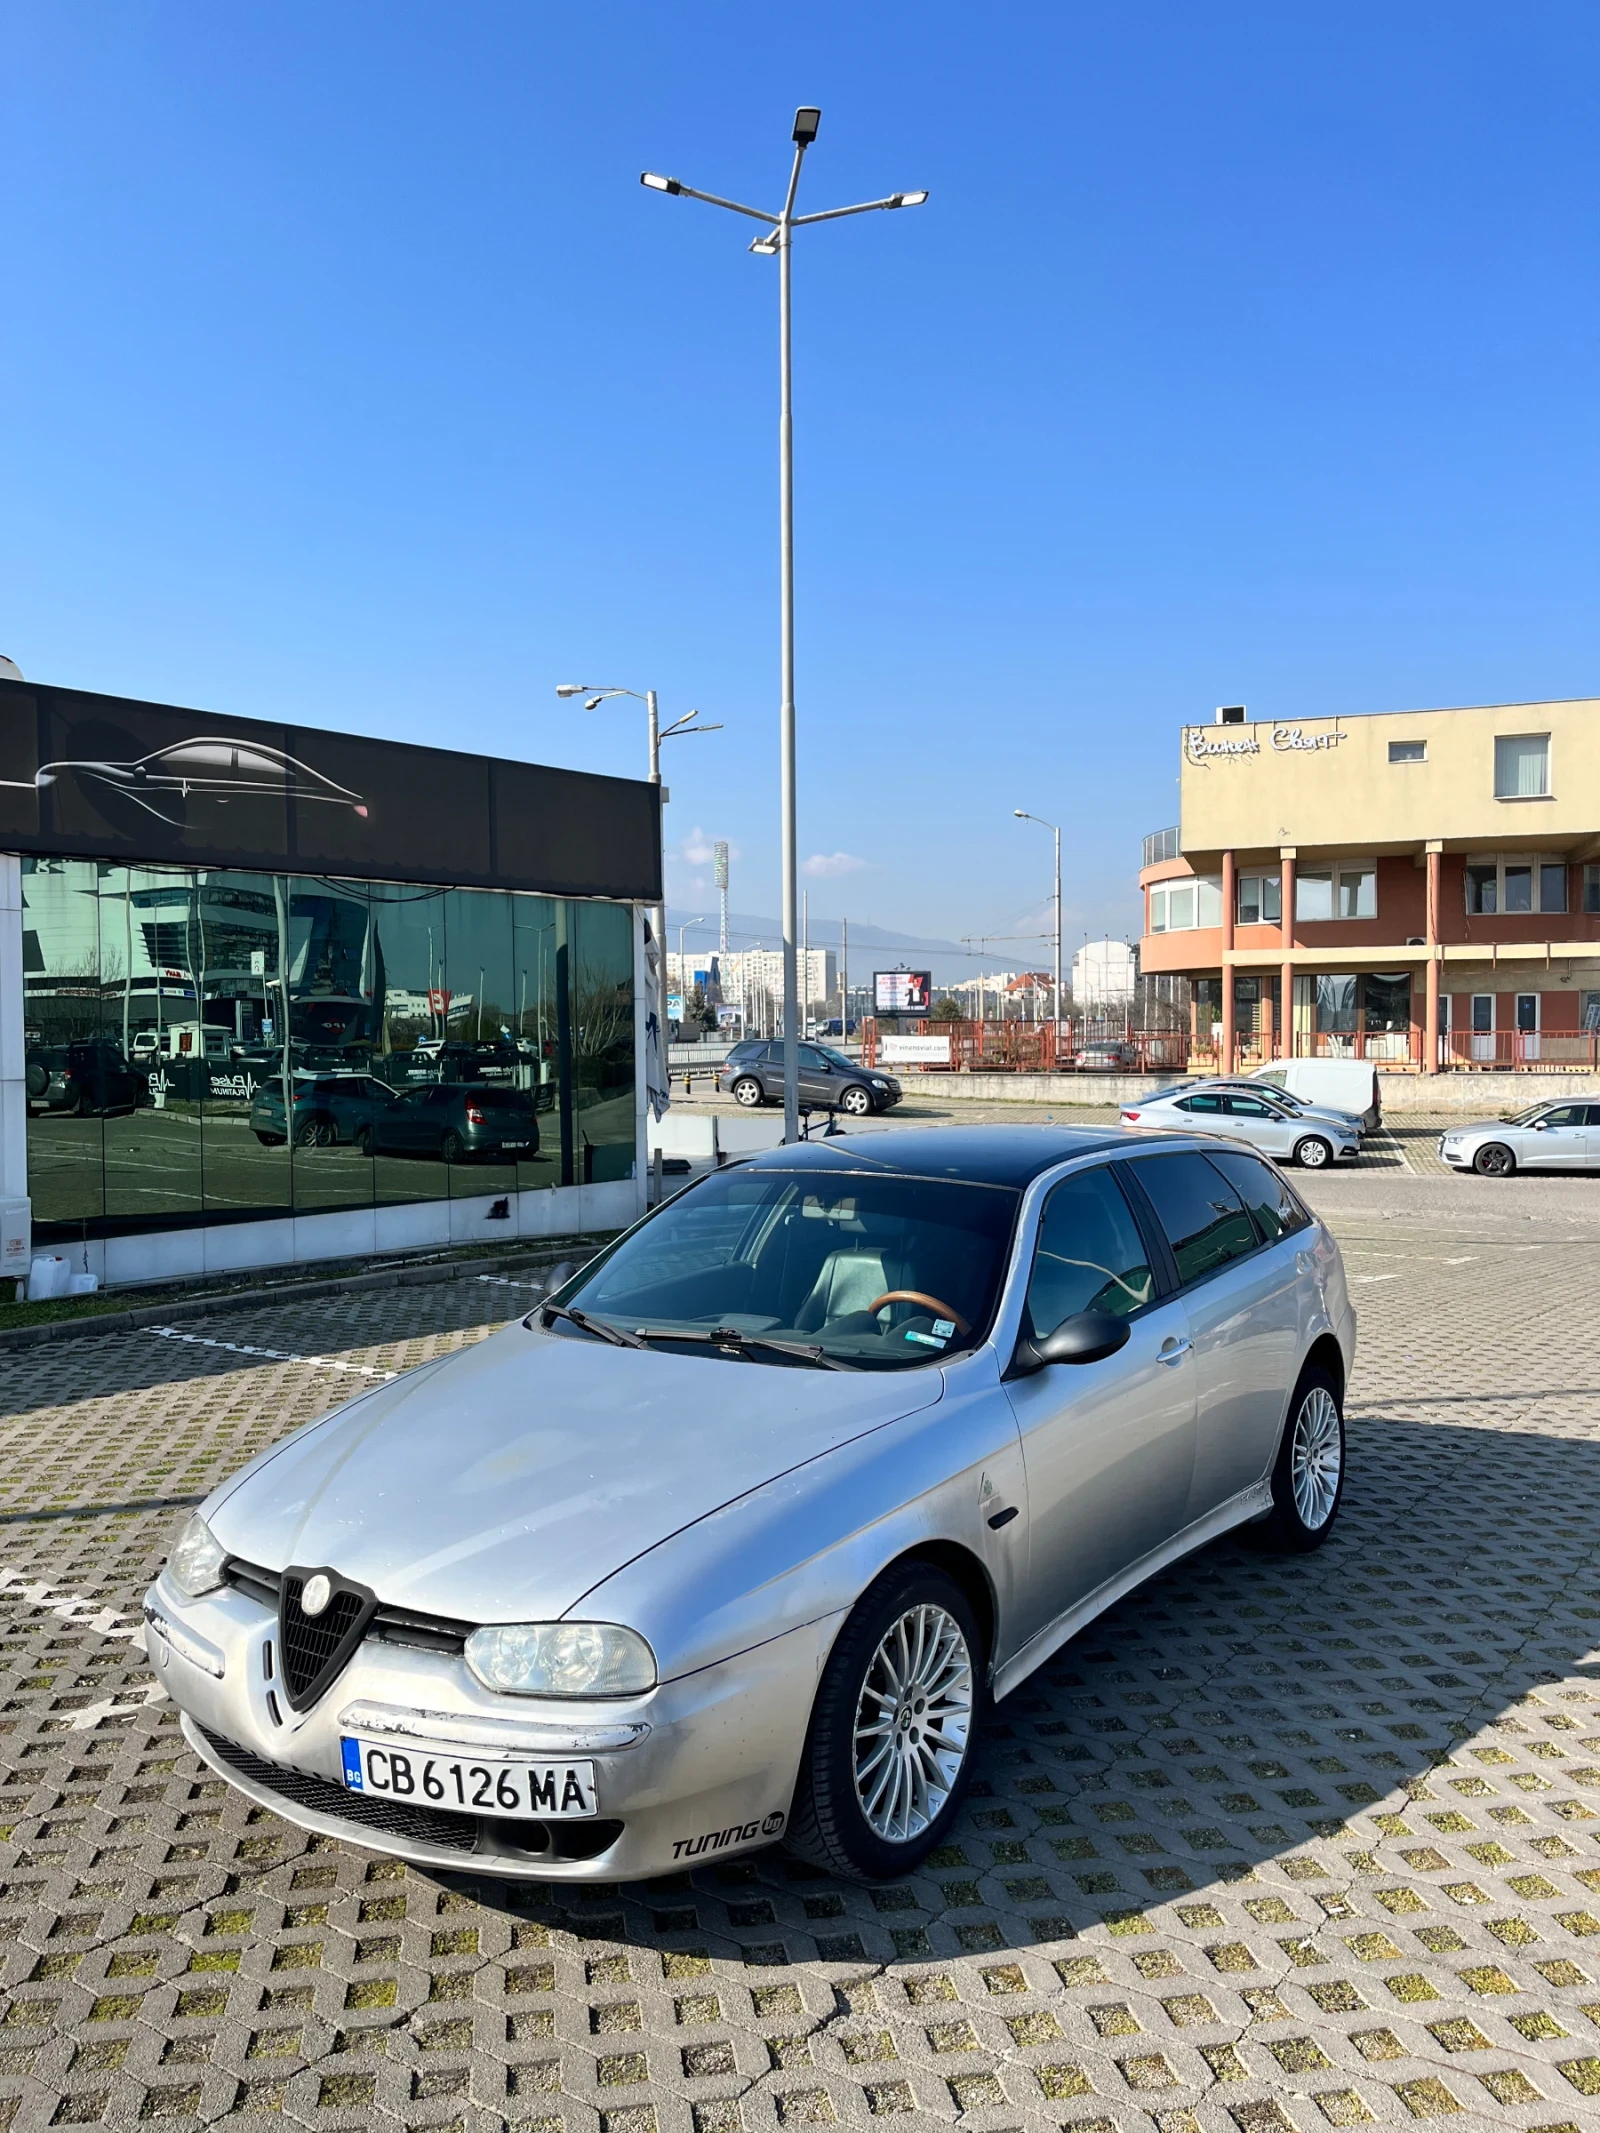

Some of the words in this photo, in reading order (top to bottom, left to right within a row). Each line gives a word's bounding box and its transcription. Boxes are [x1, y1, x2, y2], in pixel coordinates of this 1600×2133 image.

[346, 1769, 362, 1784] BG
[366, 1749, 416, 1795] CB
[422, 1759, 520, 1810] 6126
[527, 1769, 588, 1812] MA
[672, 1819, 761, 1860] TUNING
